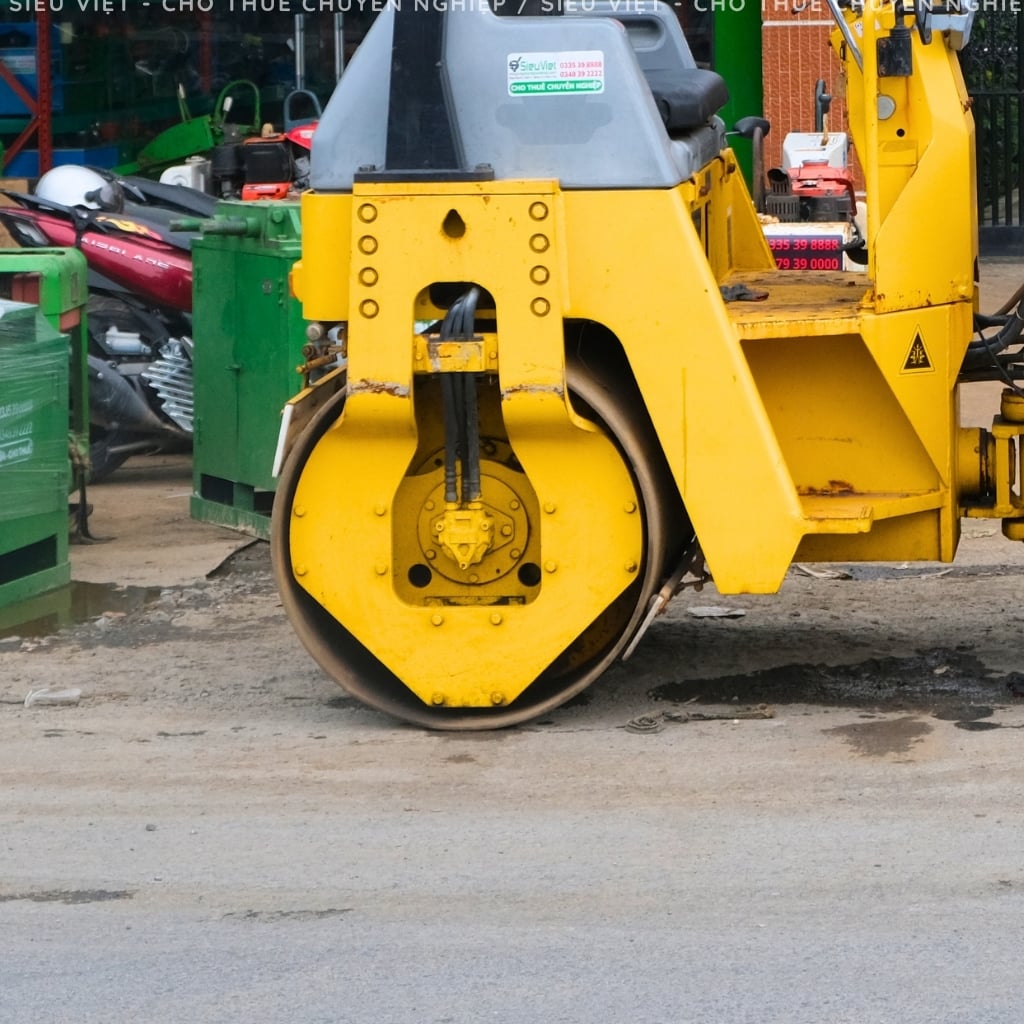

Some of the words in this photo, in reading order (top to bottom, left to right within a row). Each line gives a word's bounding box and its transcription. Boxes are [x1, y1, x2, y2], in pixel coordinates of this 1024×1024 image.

[793, 239, 808, 250] 39
[810, 239, 839, 250] 8888
[793, 258, 808, 269] 39
[810, 258, 839, 269] 0000
